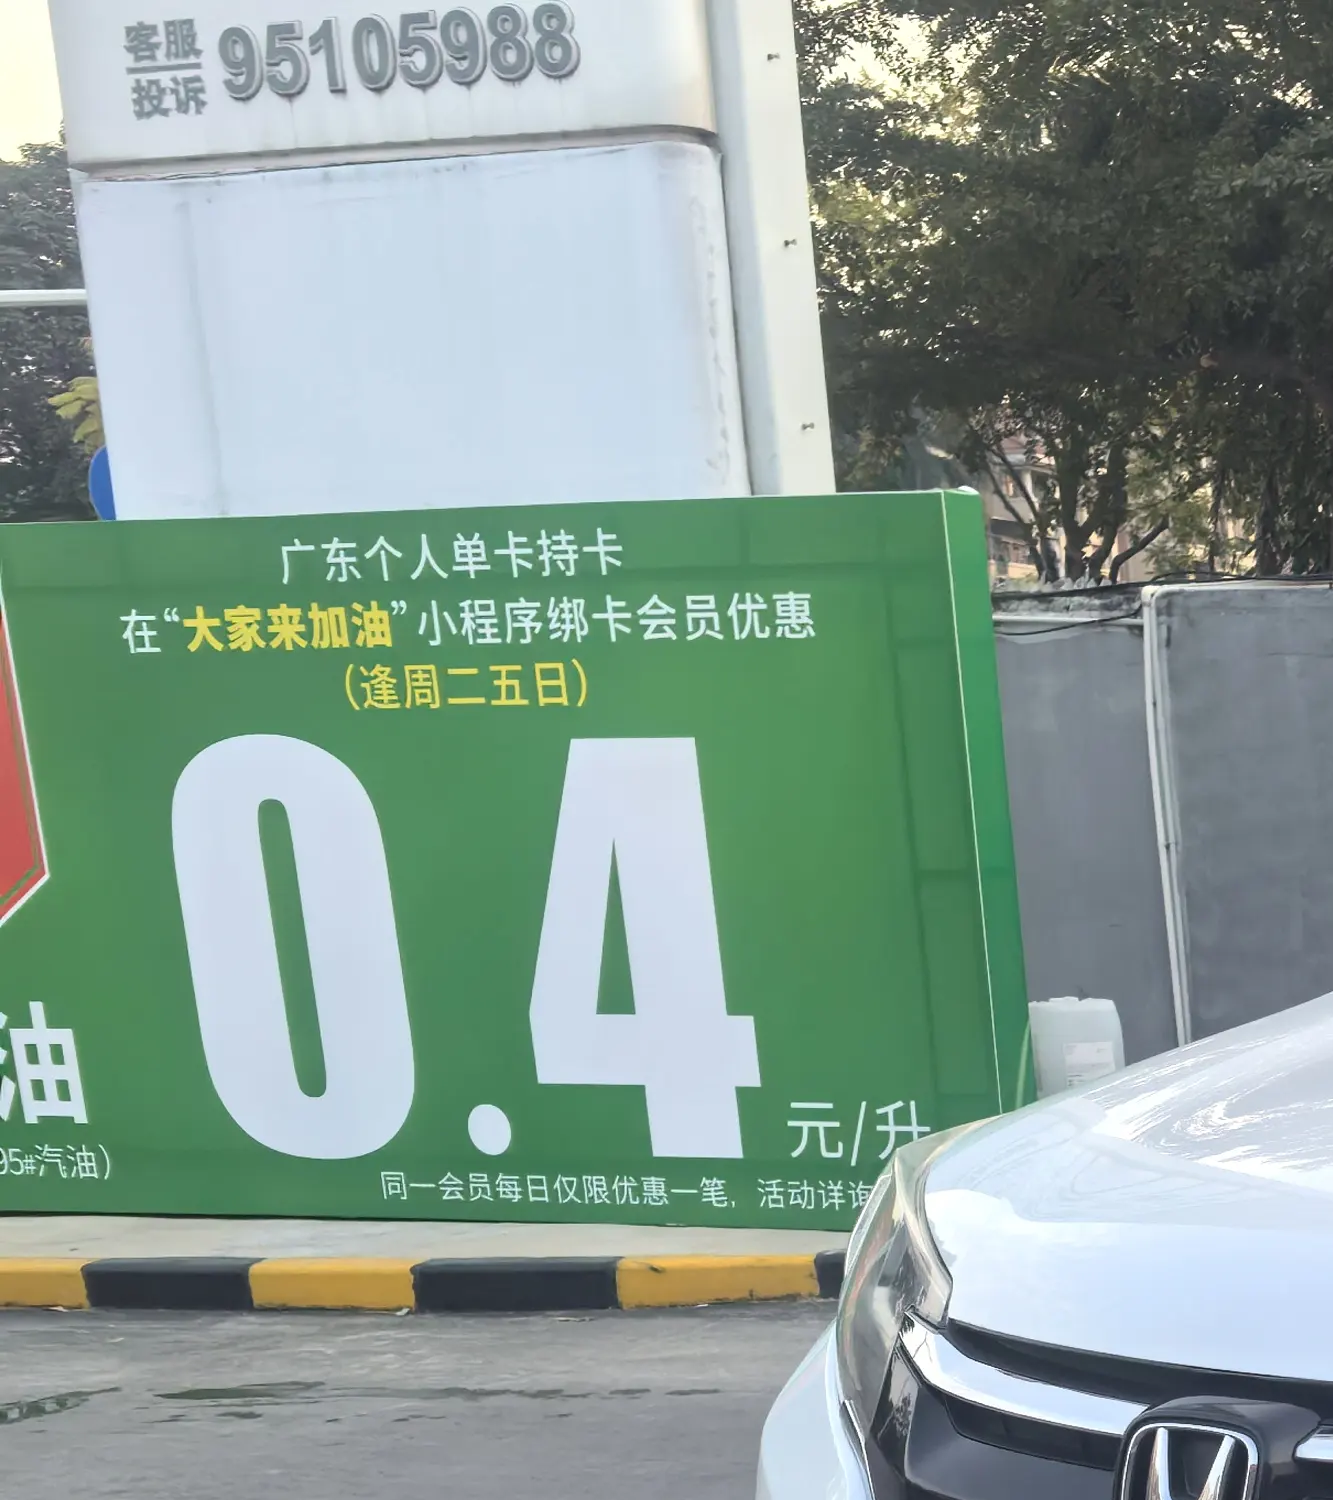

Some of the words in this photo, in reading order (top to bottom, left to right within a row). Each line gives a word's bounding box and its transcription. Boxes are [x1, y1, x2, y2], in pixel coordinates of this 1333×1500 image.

[124, 18, 202, 64] 客服
[218, 1, 581, 102] 95105988
[132, 75, 208, 121] 投诉
[280, 527, 624, 585] 广东个人单卡持卡
[171, 733, 762, 1160] 0.4
[787, 1100, 931, 1167] 元/升
[0, 1000, 89, 1124] 油
